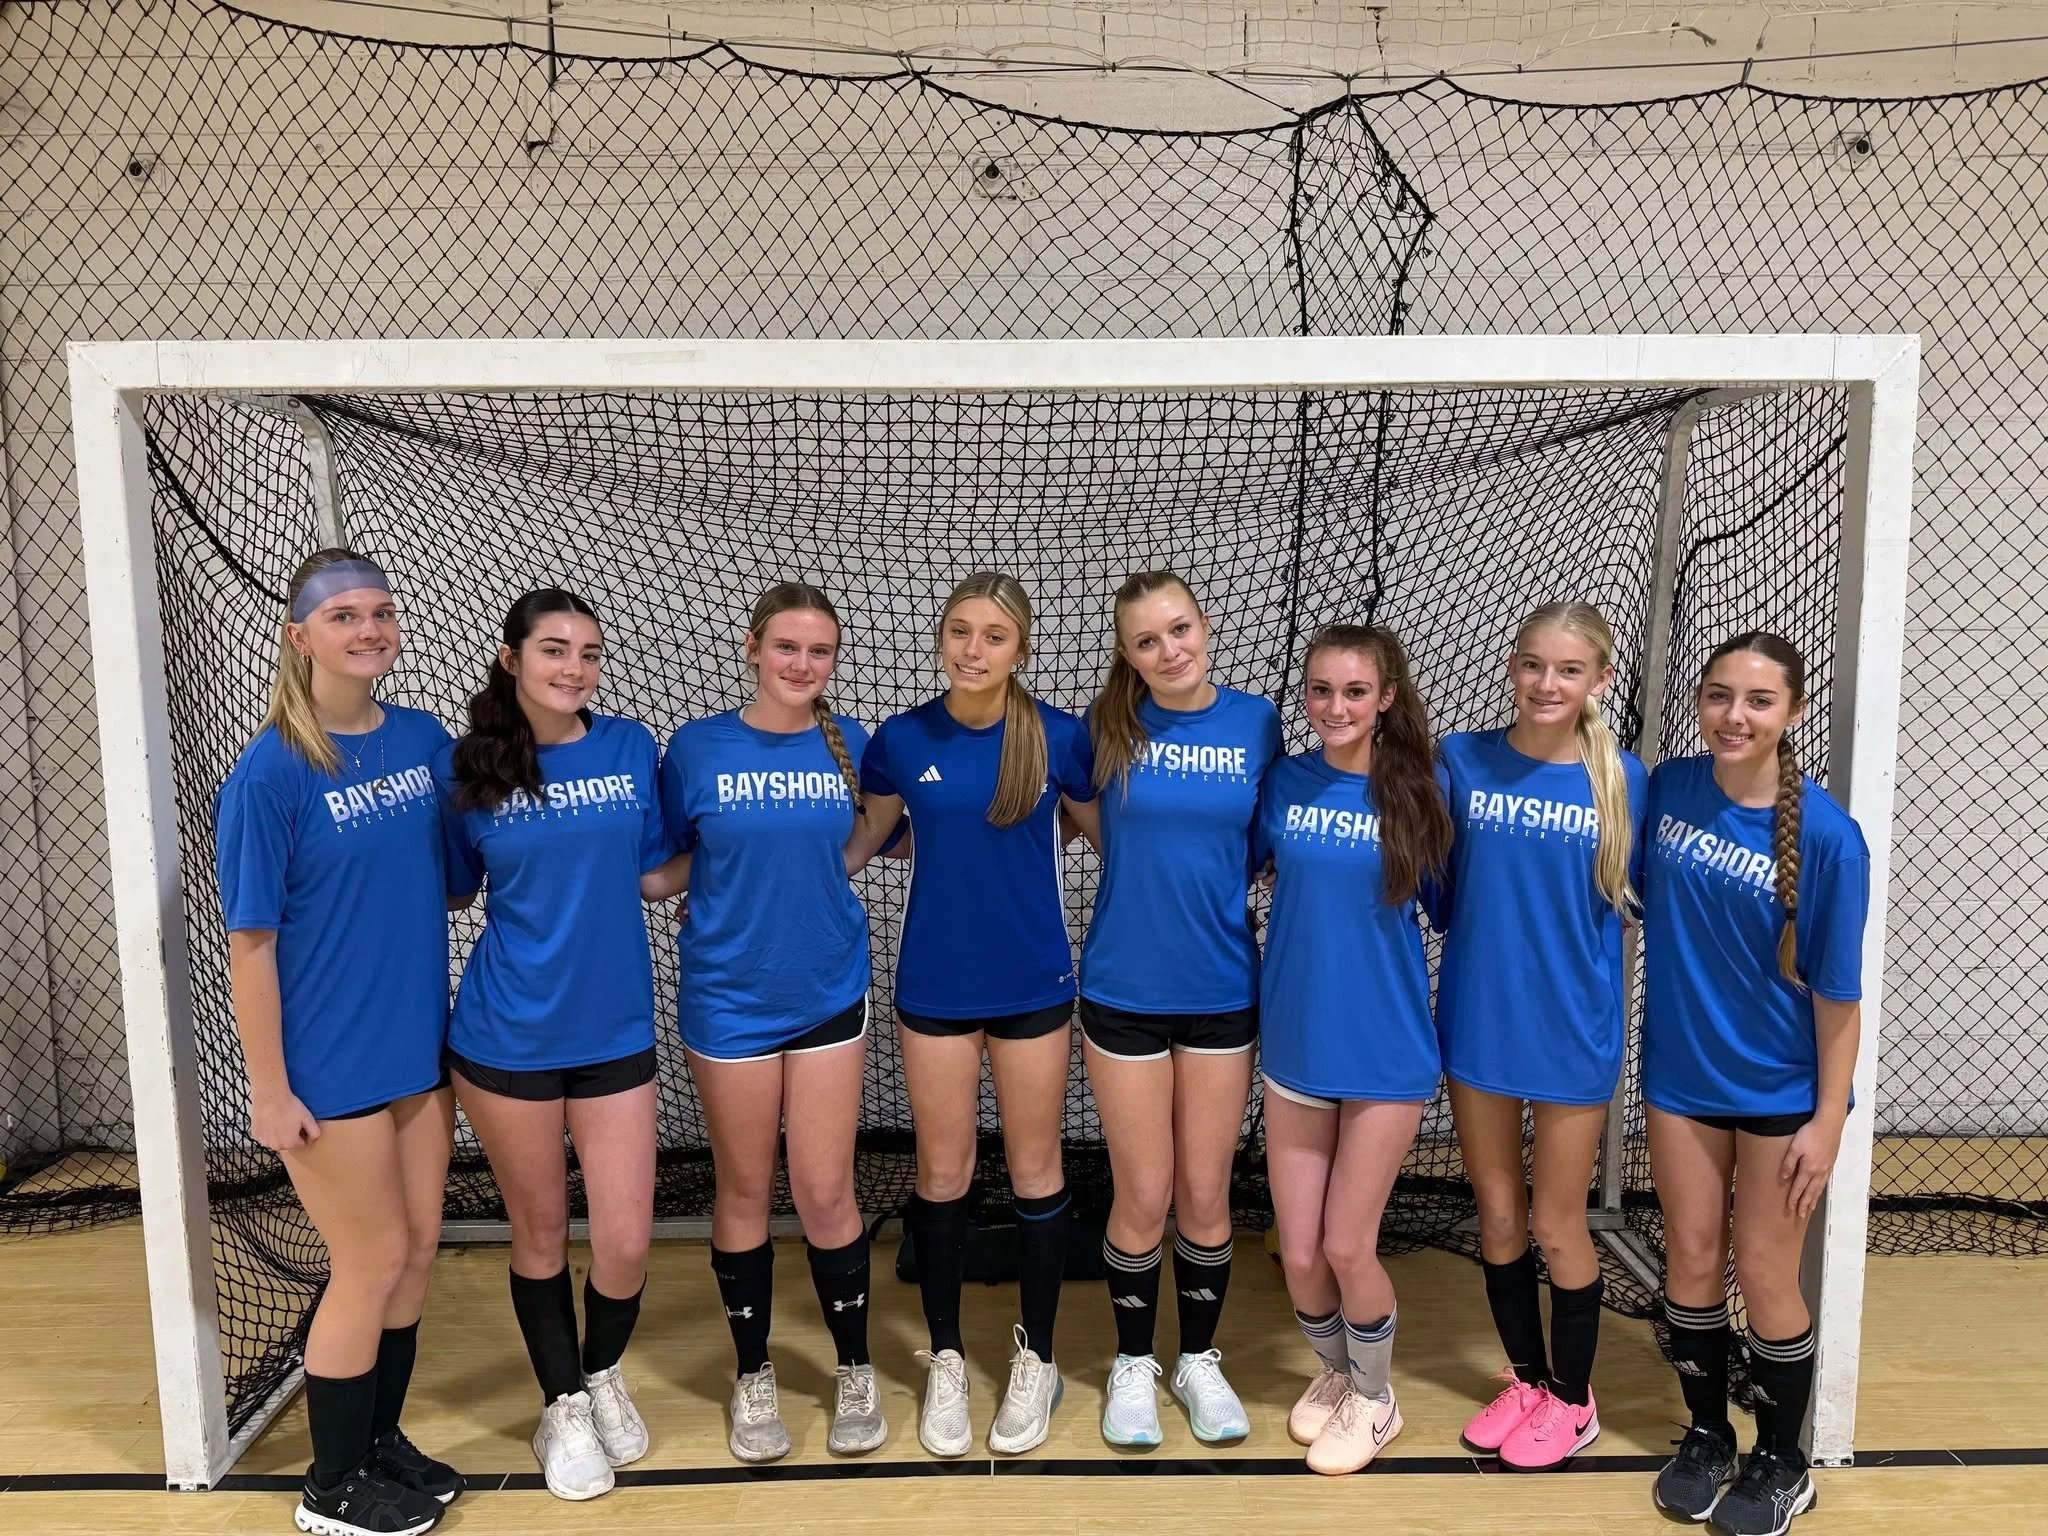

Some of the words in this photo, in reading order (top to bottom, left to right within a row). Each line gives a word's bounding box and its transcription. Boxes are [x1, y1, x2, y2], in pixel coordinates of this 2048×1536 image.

[1130, 740, 1246, 776] AYSHORE
[1129, 766, 1187, 780] CCER
[324, 765, 436, 823] BAYSHOR
[718, 801, 794, 813] SOCCER
[337, 805, 408, 834] SOCCER
[494, 809, 579, 827] SOCCER
[1285, 804, 1383, 843] BAYSHO
[1468, 790, 1600, 840] BAYSHOR
[1283, 833, 1360, 849] SOCCER
[1467, 821, 1545, 840] SOCCER
[1564, 835, 1598, 849] CLU
[1724, 877, 1776, 904] CLUB
